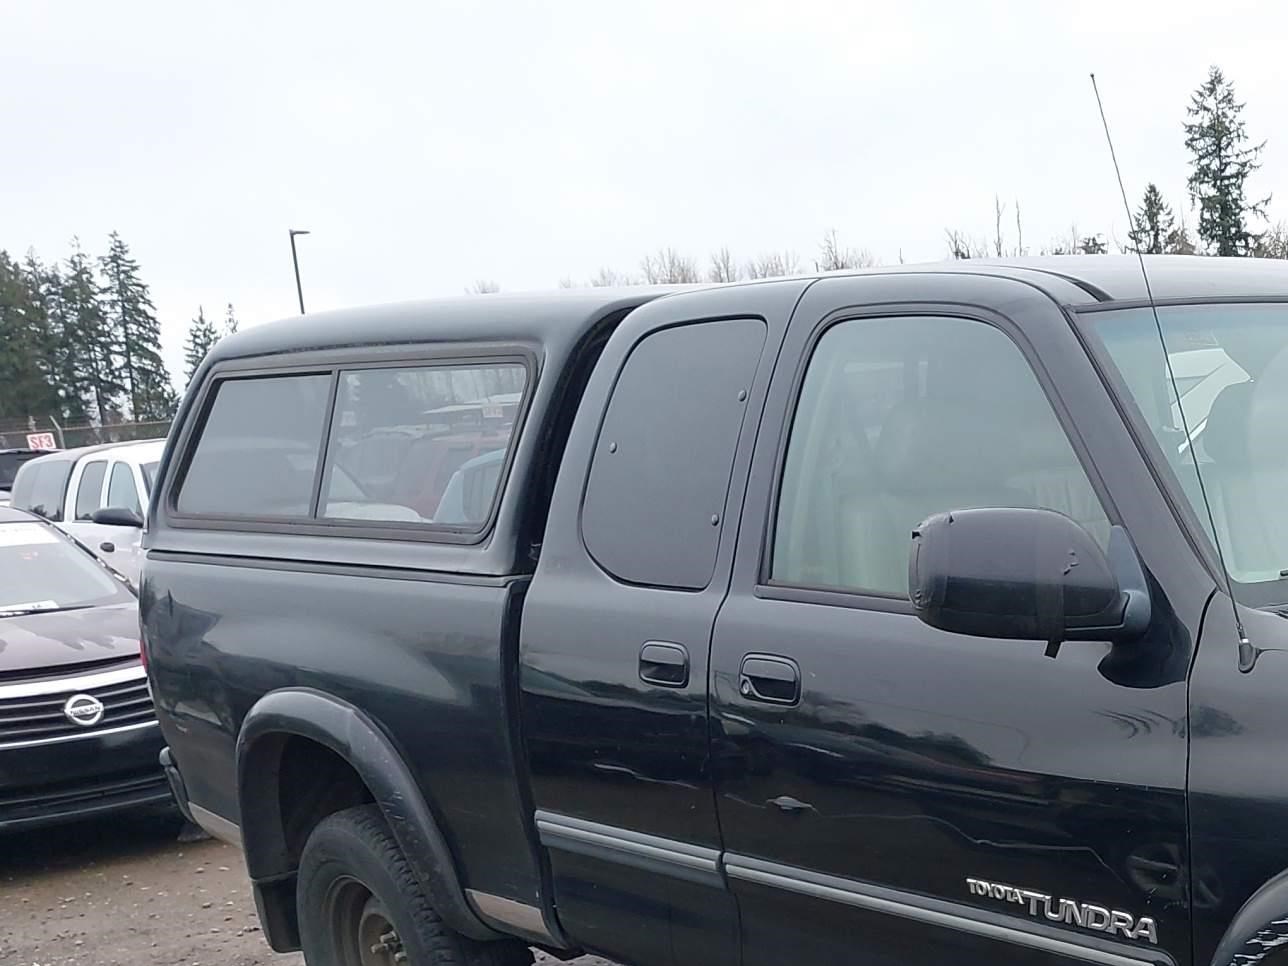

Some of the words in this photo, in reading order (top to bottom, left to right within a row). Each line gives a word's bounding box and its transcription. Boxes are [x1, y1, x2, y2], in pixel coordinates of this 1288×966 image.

[30, 434, 53, 449] SF3
[965, 878, 1025, 905] TOYOTA
[1021, 890, 1159, 945] TUNDRA
